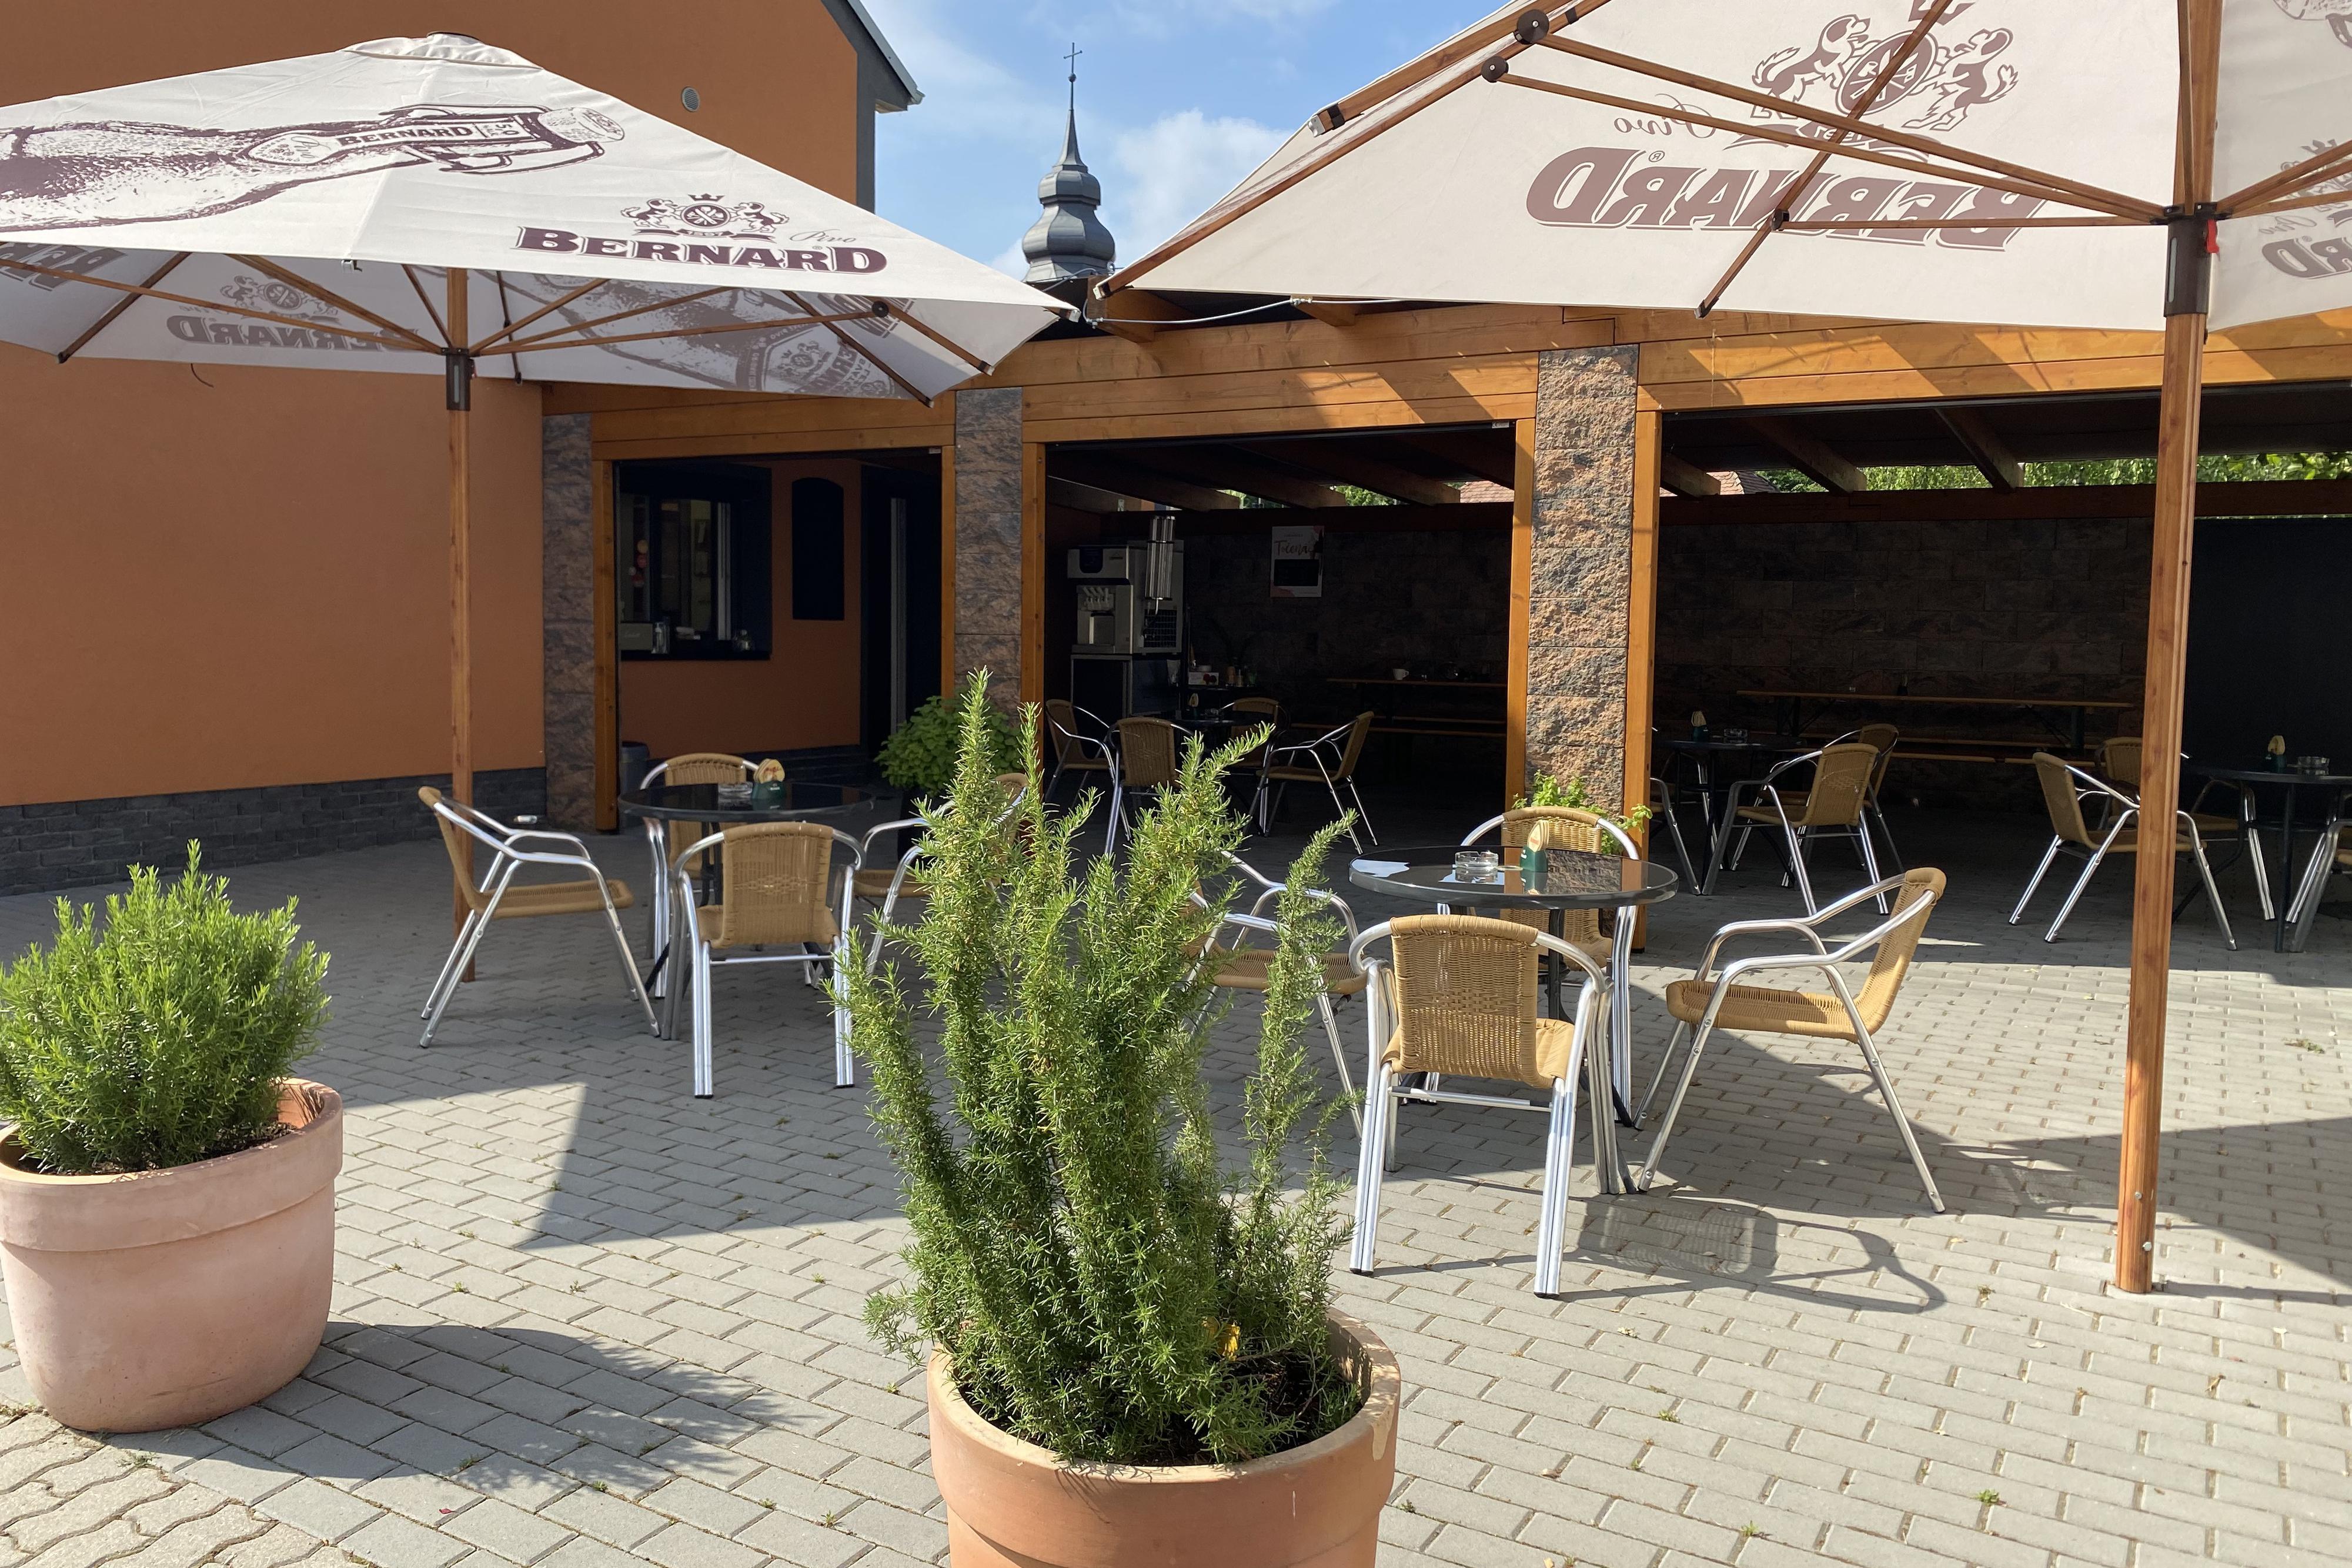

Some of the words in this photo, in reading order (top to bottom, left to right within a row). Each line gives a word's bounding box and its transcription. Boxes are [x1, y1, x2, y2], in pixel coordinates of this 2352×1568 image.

[336, 126, 473, 147] BERNARD
[789, 228, 857, 244] Pivo
[510, 226, 888, 275] BERNARD
